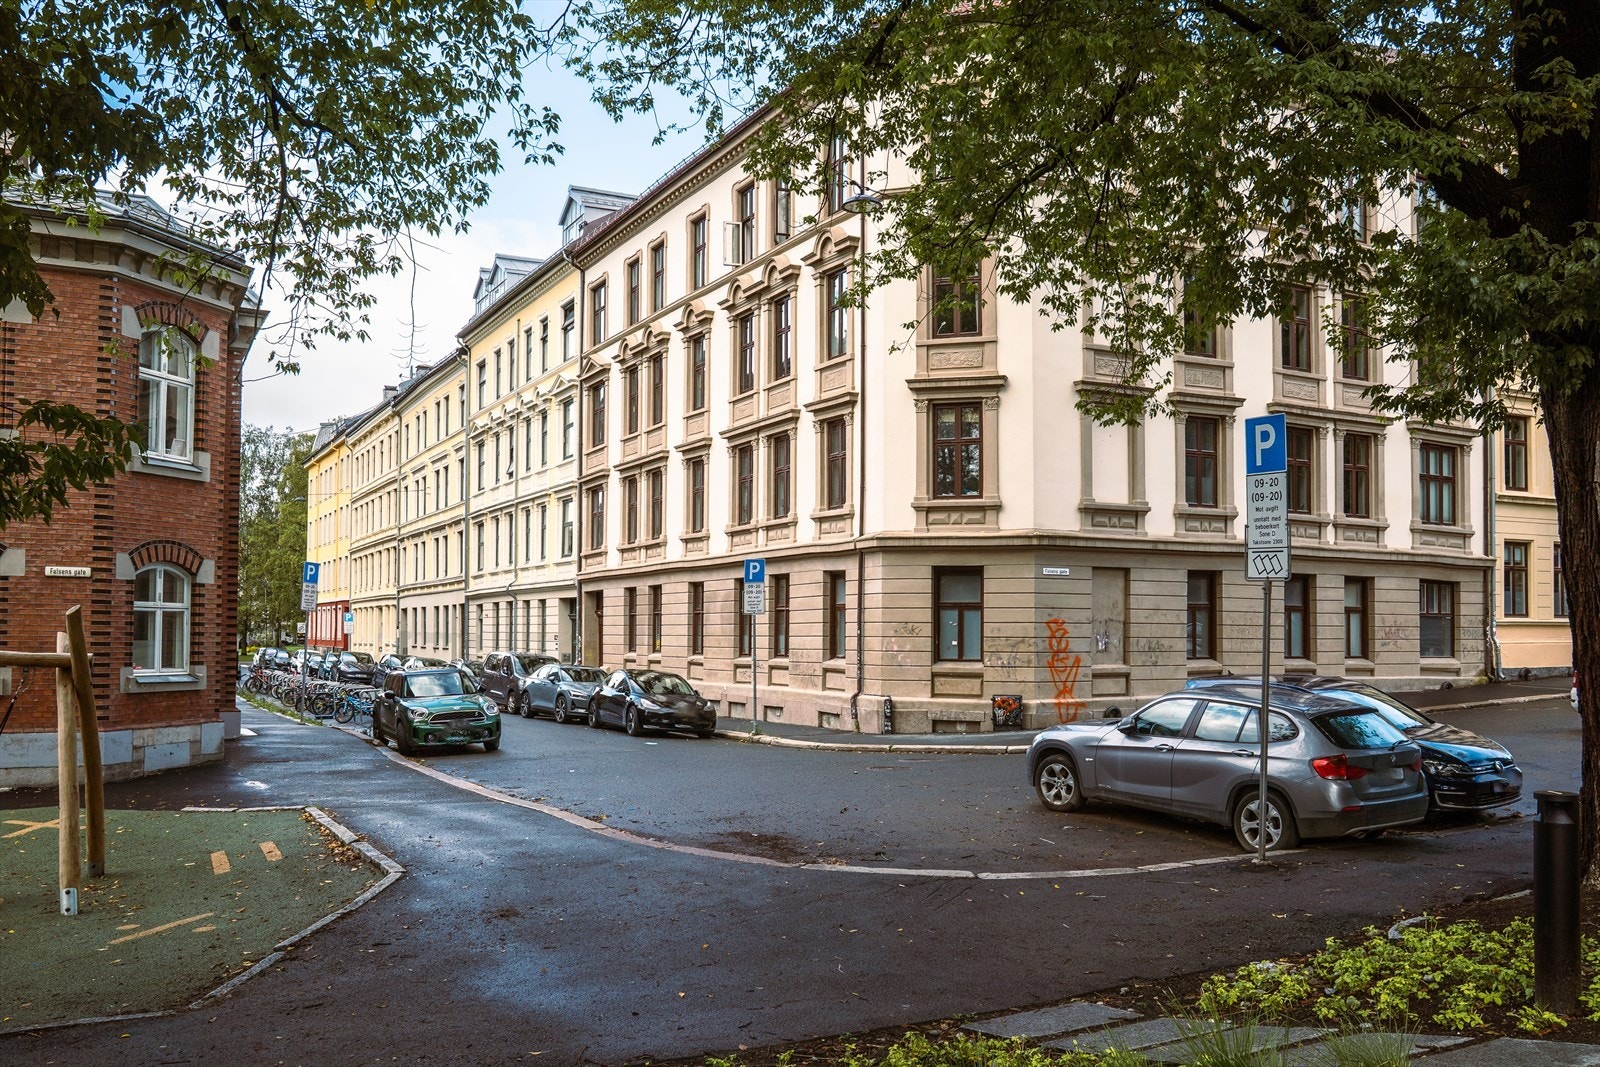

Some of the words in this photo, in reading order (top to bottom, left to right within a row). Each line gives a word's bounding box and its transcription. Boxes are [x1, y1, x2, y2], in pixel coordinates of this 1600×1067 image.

[1255, 423, 1276, 466] P
[1254, 477, 1279, 488] 09-20
[1251, 490, 1282, 503] (09-20)
[306, 565, 316, 580] P
[749, 562, 760, 580] P
